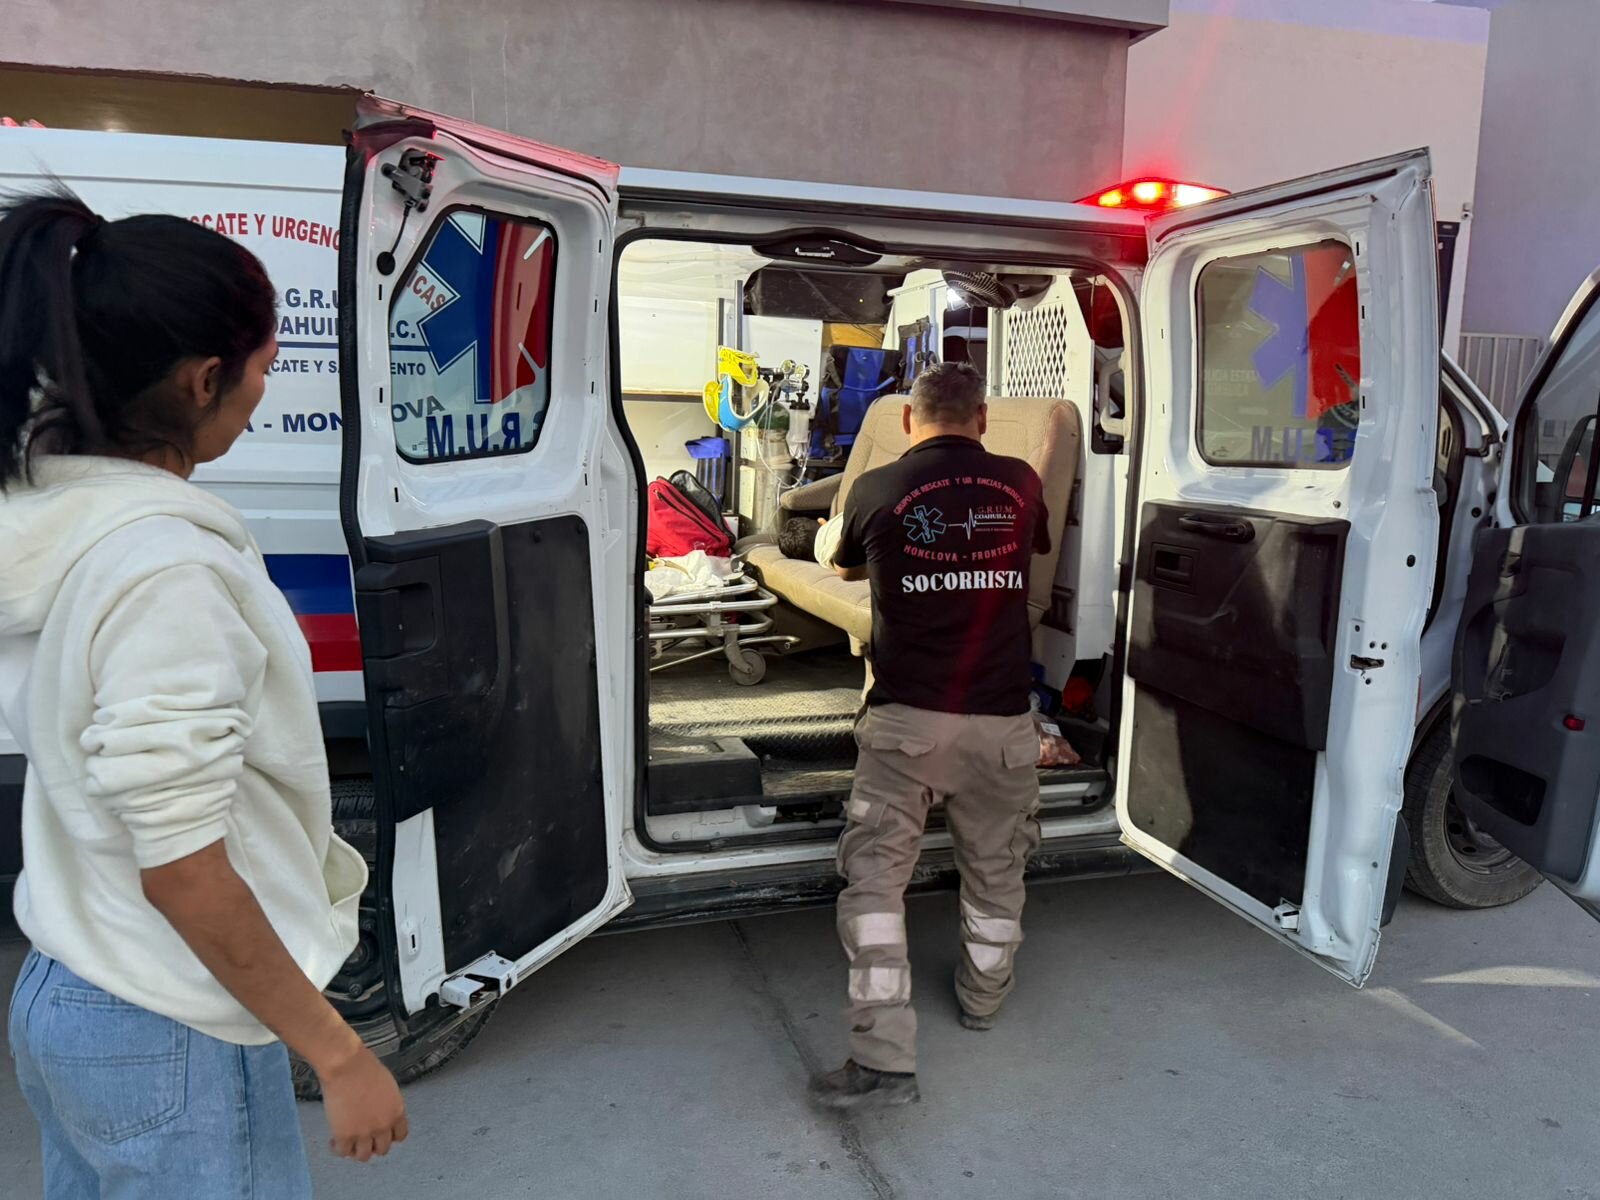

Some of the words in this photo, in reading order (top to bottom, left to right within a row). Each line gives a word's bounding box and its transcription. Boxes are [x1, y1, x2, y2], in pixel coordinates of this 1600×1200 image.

[254, 213, 266, 236] Y
[313, 359, 324, 374] Y
[328, 360, 340, 374] S
[391, 394, 446, 423] OVA
[910, 487, 922, 499] DE
[920, 478, 951, 493] RESCATE
[955, 477, 960, 486] Y
[904, 545, 958, 562] MONCLOVA
[971, 541, 1019, 561] FRONTERA
[902, 570, 1022, 593] SOCORRISTA
